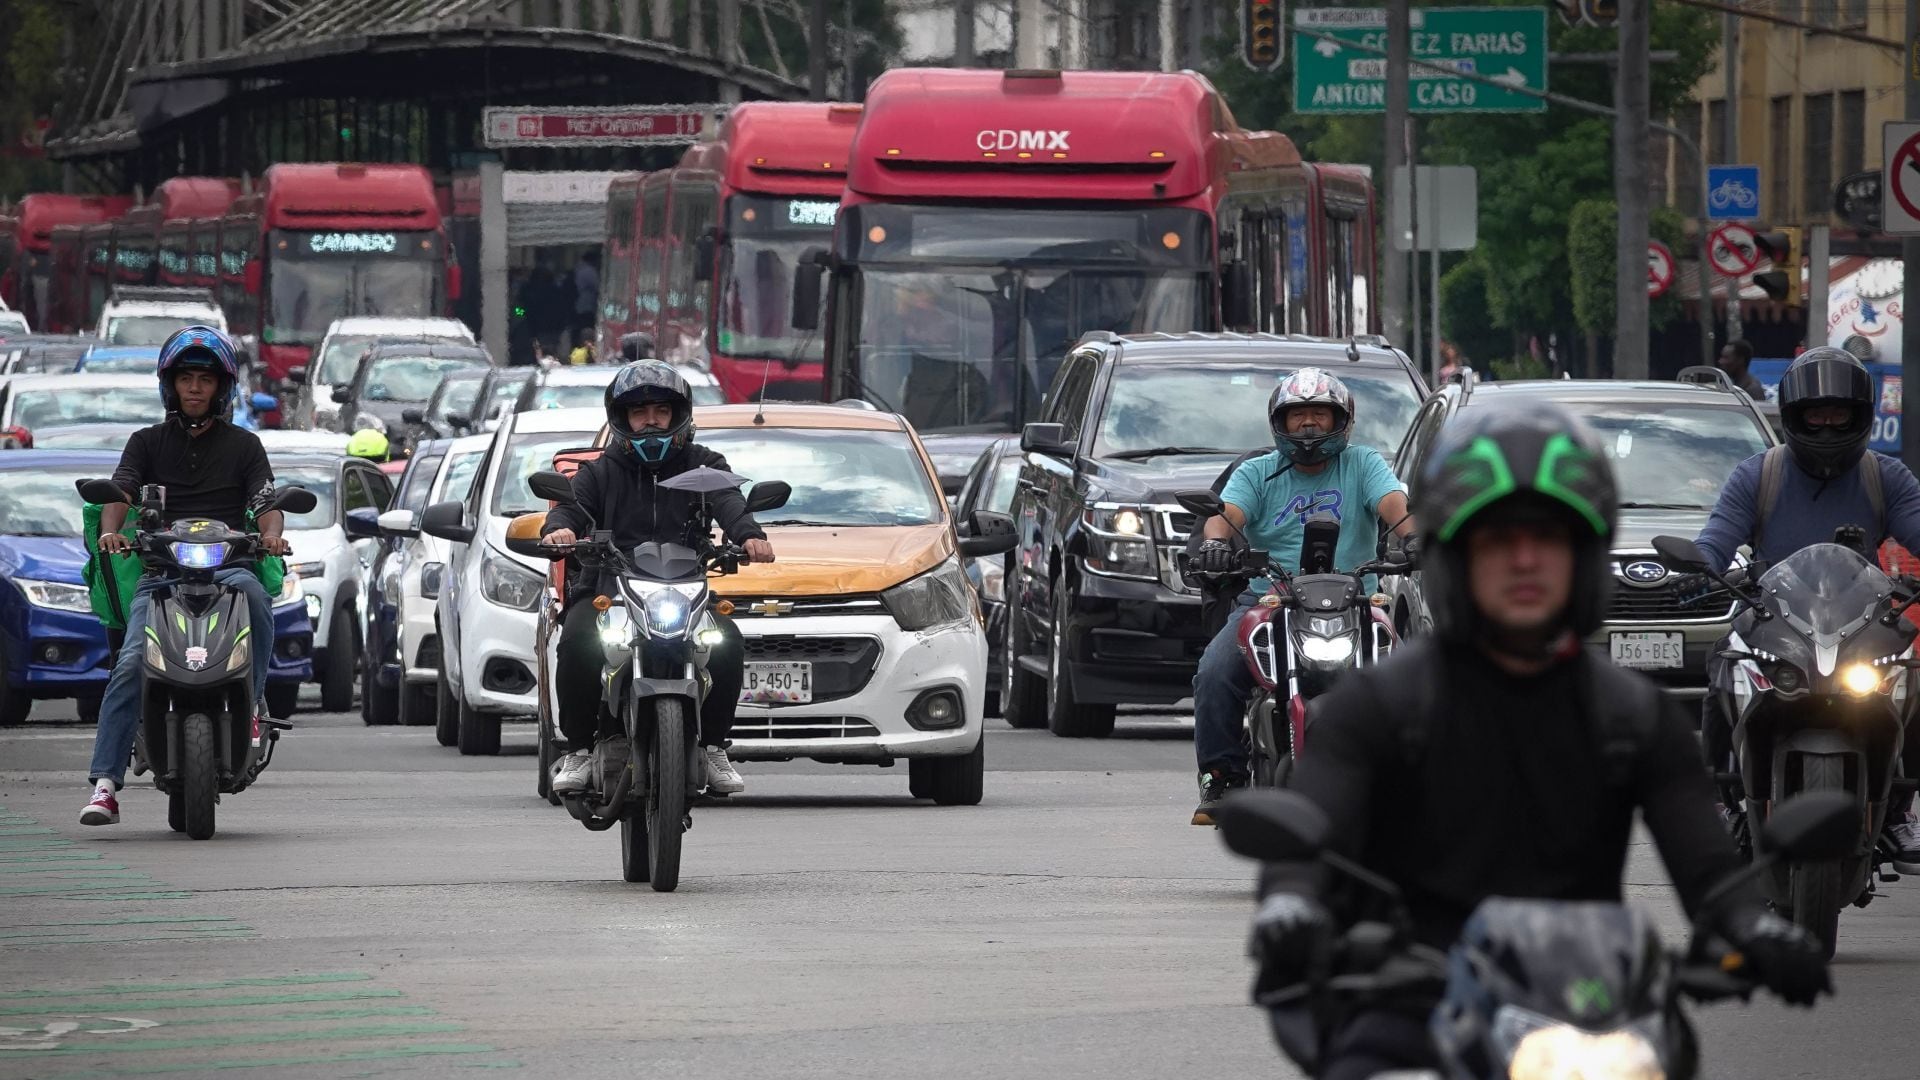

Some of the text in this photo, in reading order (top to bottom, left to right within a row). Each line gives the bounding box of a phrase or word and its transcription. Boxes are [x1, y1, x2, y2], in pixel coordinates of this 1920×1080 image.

[1361, 31, 1527, 54] GOEZ FARIAS
[1311, 83, 1476, 105] ANTON CASO
[566, 116, 654, 134] REFORMA
[976, 129, 1071, 150] CDMX
[1274, 489, 1344, 527] AIR
[1616, 642, 1681, 660] J56-BES
